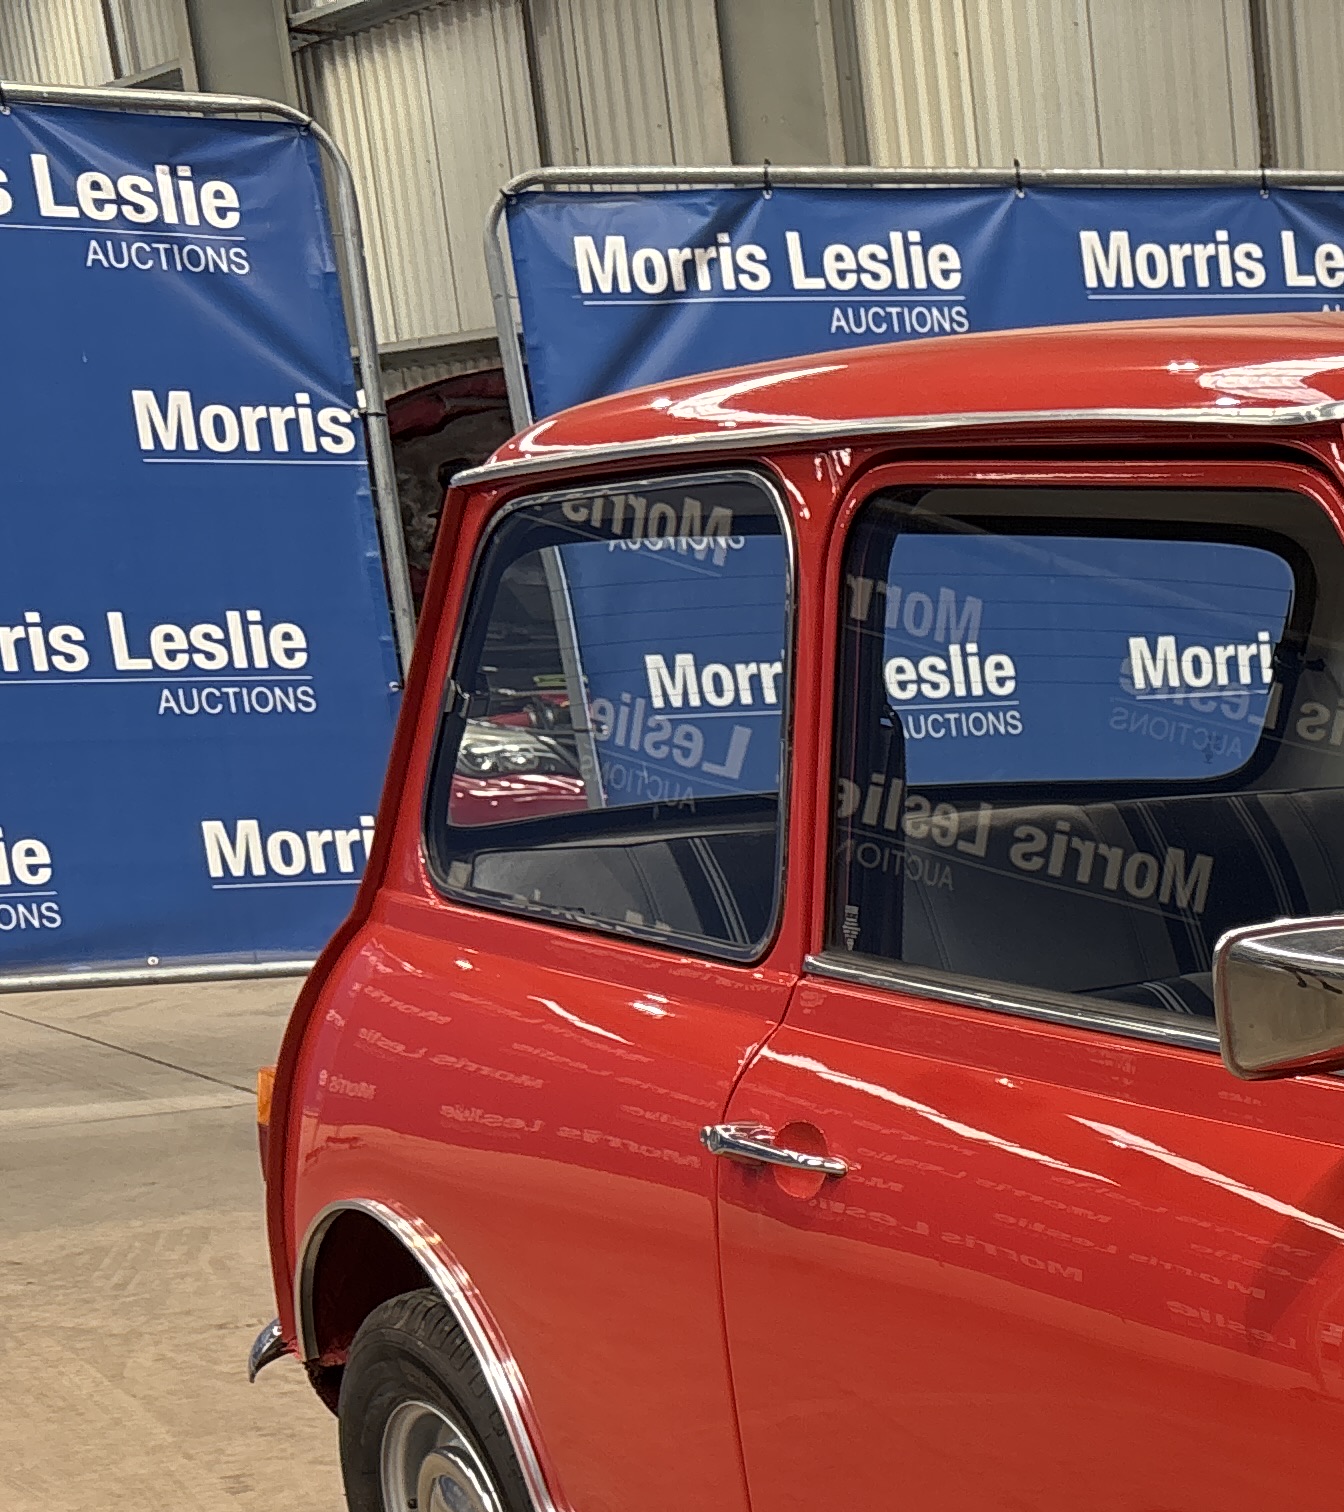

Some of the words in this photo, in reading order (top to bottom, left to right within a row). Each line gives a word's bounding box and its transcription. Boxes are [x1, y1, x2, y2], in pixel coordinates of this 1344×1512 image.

[29, 153, 241, 229] Leslie
[86, 239, 251, 275] AUCTIONS
[572, 232, 772, 294] Morris
[784, 229, 962, 291] Leslie
[1078, 229, 1267, 289] Morris
[830, 305, 970, 334] AUCTIONS
[131, 389, 357, 455] Morris
[0, 611, 90, 673] ris
[106, 609, 308, 671] Leslie
[1128, 630, 1274, 690] Morri
[158, 685, 317, 715] AUCTIONS
[644, 653, 783, 709] Morr
[883, 642, 1016, 701] eslie
[200, 814, 376, 878] Morri
